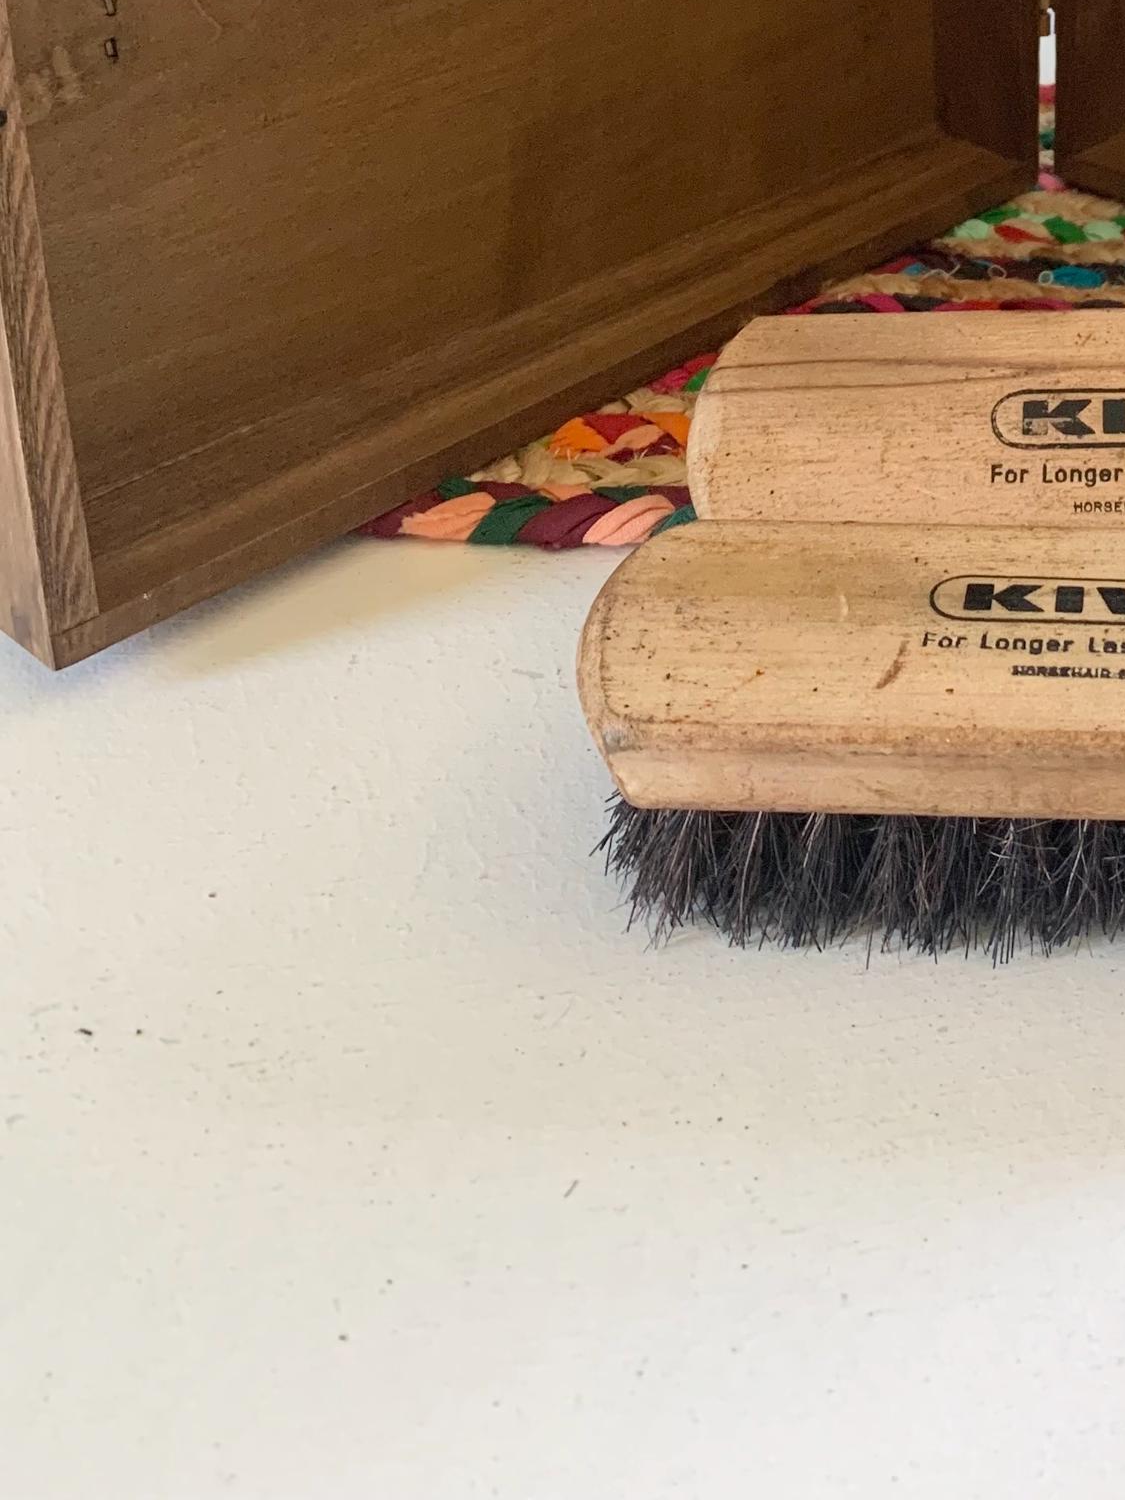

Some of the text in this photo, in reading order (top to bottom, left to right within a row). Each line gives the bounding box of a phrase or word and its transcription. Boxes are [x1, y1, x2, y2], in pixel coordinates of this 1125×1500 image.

[990, 464, 1029, 484] For
[1042, 464, 1123, 487] Longer
[922, 632, 967, 650] For
[980, 633, 1074, 656] Longer
